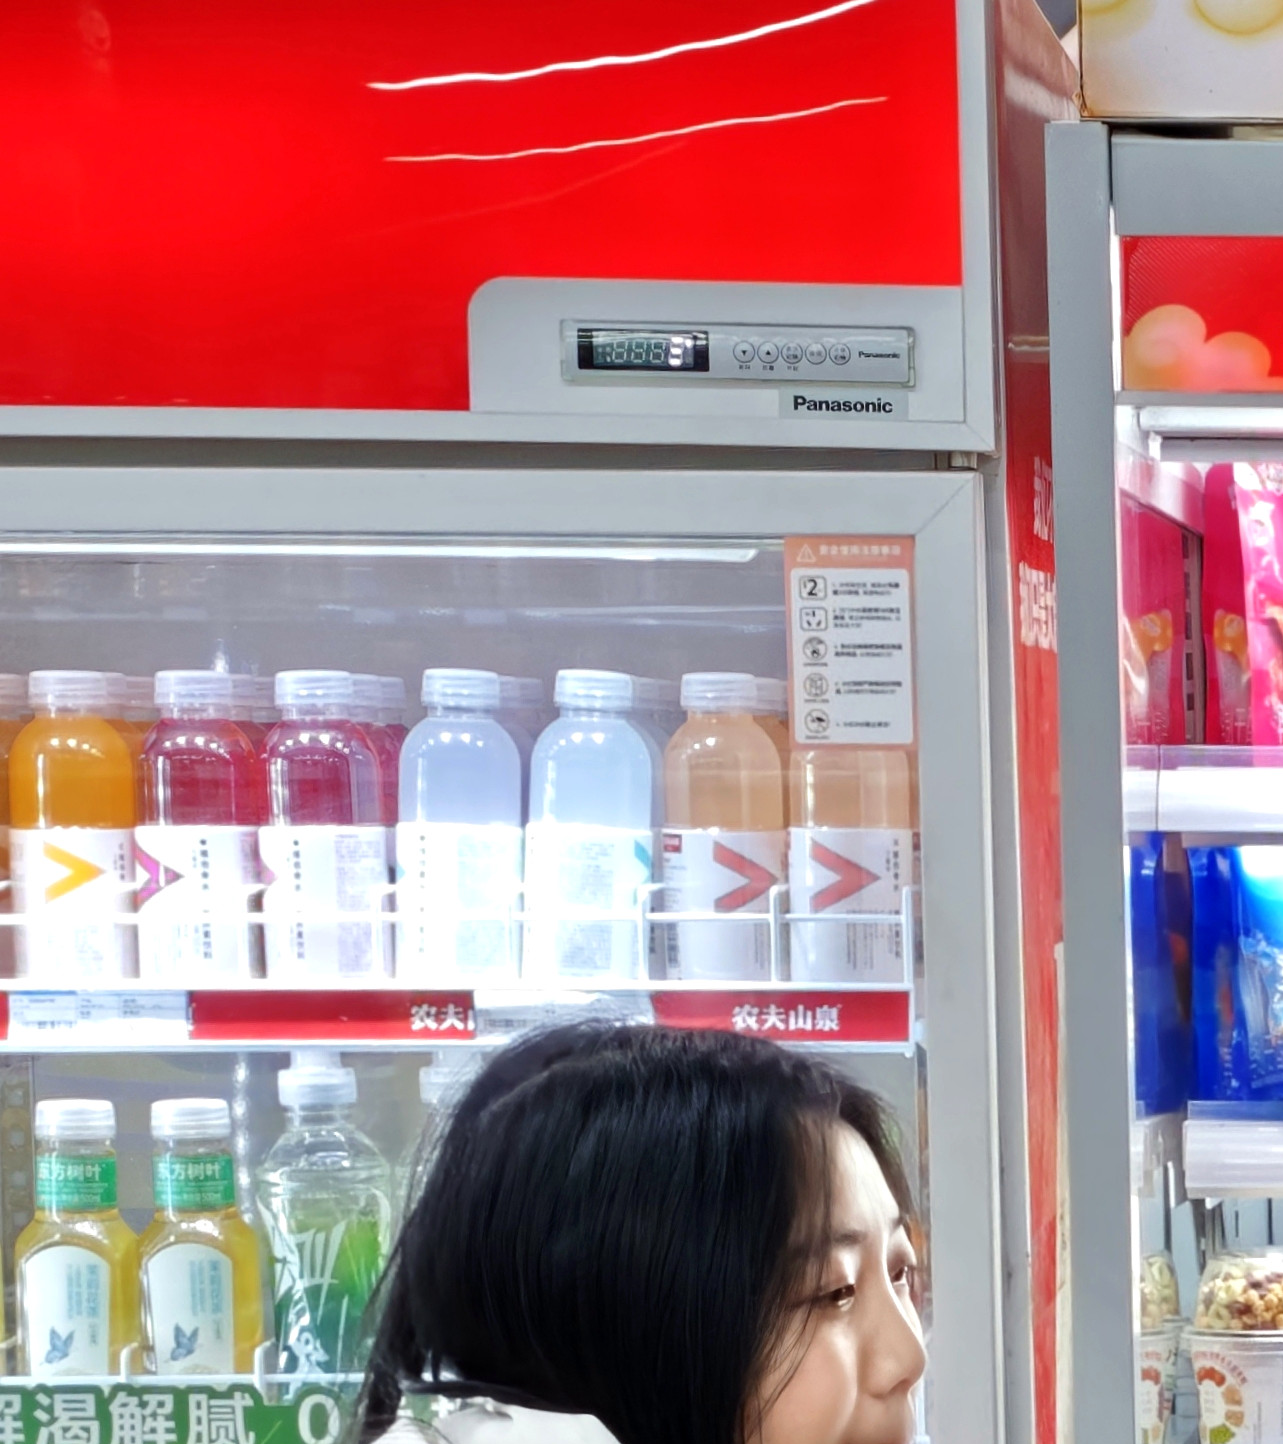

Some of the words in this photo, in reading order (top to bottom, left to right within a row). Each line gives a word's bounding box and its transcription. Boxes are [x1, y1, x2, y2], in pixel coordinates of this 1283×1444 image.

[793, 395, 894, 414] Panasonic
[411, 1003, 475, 1031] 农夫
[732, 1004, 841, 1032] 农夫山泉
